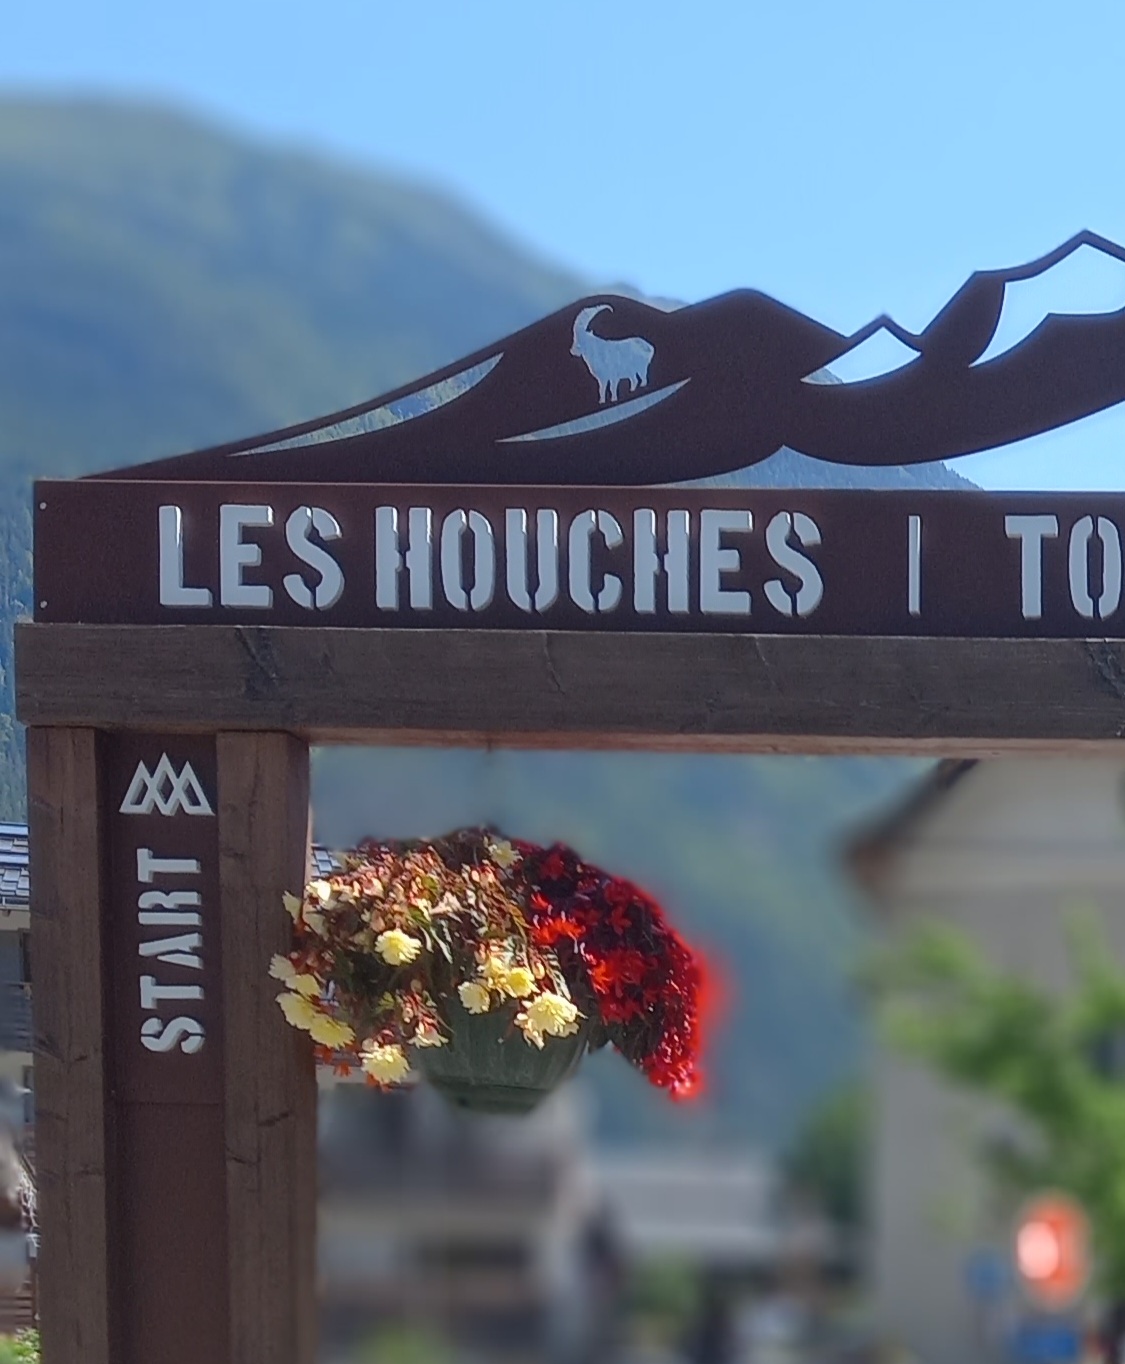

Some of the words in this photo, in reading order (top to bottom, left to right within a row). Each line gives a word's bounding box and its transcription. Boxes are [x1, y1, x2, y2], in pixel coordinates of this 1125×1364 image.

[158, 503, 345, 610] LES
[375, 506, 825, 618] HOUCHES
[136, 848, 206, 1055] START
